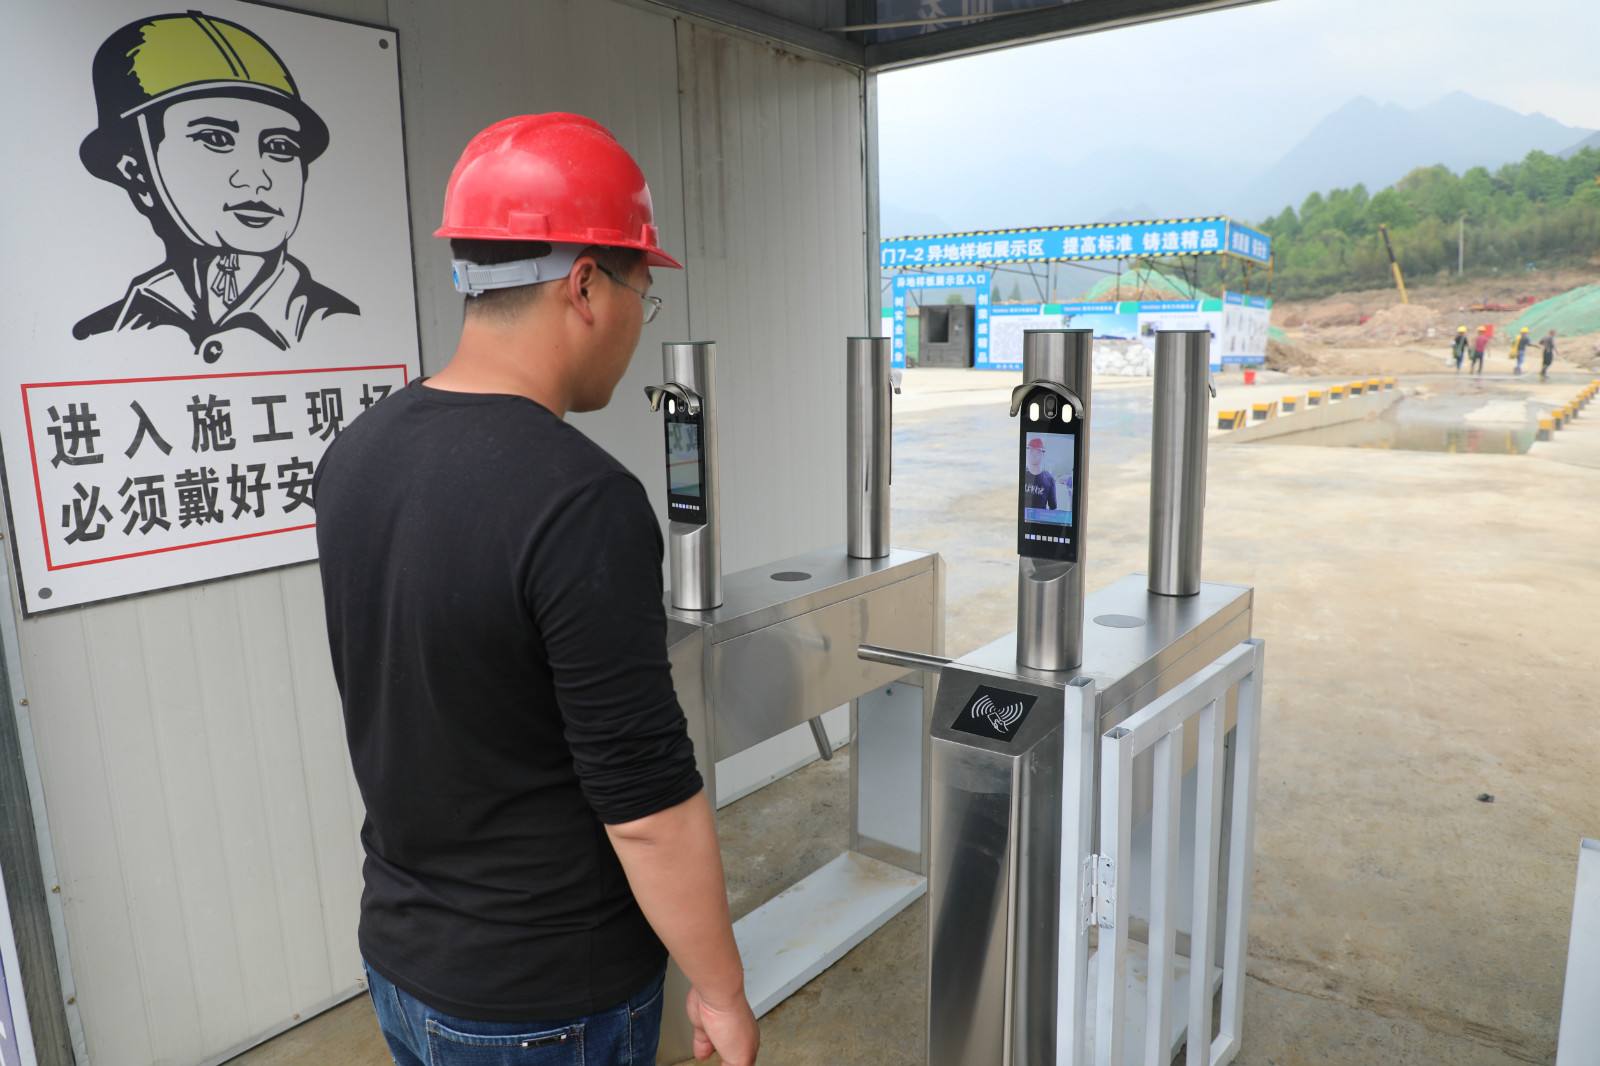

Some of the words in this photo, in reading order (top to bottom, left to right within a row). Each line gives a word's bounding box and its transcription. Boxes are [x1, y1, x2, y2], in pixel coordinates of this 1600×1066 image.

[1062, 233, 1133, 255] 提高标准
[1142, 229, 1219, 252] 铸造精品
[61, 456, 316, 546] 必须戴好安
